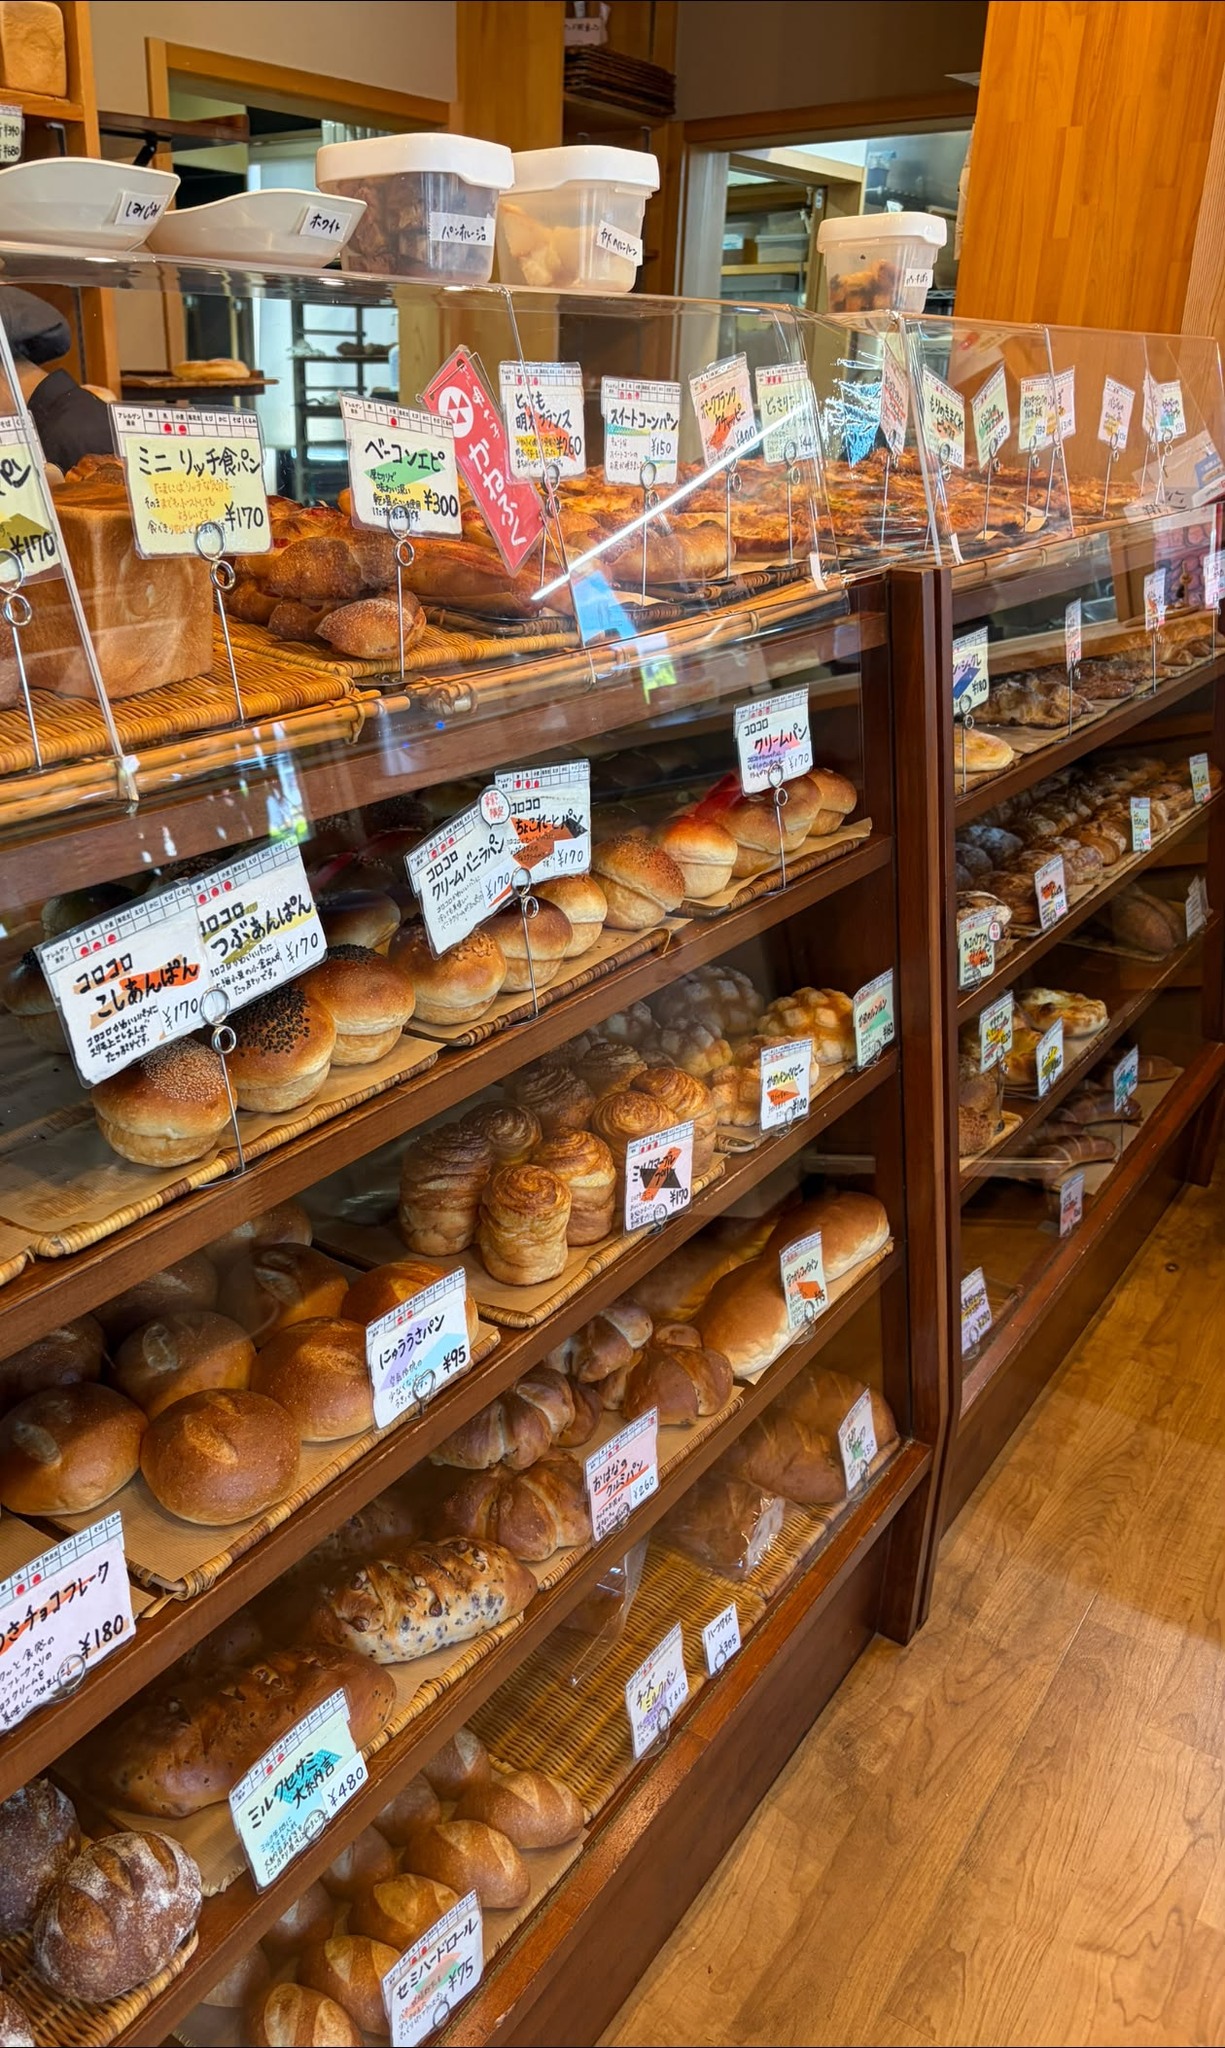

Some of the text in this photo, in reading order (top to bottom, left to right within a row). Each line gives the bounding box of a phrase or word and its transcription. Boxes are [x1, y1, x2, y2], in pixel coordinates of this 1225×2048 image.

[310, 213, 341, 233] ホワイト
[610, 407, 679, 431] スイートコーンパン
[364, 437, 446, 473] ベーコンエピ
[556, 435, 582, 457] ¥260
[651, 437, 672, 457] ¥150
[423, 488, 459, 518] ¥300
[467, 437, 528, 547] かねふく
[224, 501, 264, 532] ¥170
[744, 718, 769, 737] コロコロ
[754, 722, 808, 755] クリームパン
[788, 753, 810, 771] ¥170
[510, 797, 541, 815] コロコロ
[515, 808, 584, 837] ちょこれーとパン
[426, 850, 459, 884] コロコロ
[431, 833, 505, 901] クリームバニラパン
[557, 848, 584, 868] ¥170
[485, 871, 511, 902] ¥170
[210, 893, 312, 957] つぶあんぱん
[282, 932, 319, 965] ¥170
[75, 953, 134, 994] コロコロ
[96, 956, 200, 1018] こしあんぱん
[161, 997, 199, 1030] ¥170
[669, 1187, 689, 1208] ¥170
[379, 1314, 446, 1371] にゅううさパン
[442, 1345, 467, 1375] ¥95
[592, 1458, 628, 1492] おはなの
[606, 1459, 644, 1498] クルミパン
[633, 1475, 656, 1499] ¥260
[78, 1614, 125, 1660] ¥180
[636, 1672, 656, 1710] チーズ
[248, 1751, 315, 1829] ミルクセサミ
[292, 1754, 335, 1811] 大納言
[328, 1765, 364, 1808] ¥480
[396, 1917, 479, 2001] セミハードロール
[448, 1956, 474, 1994] ¥75
